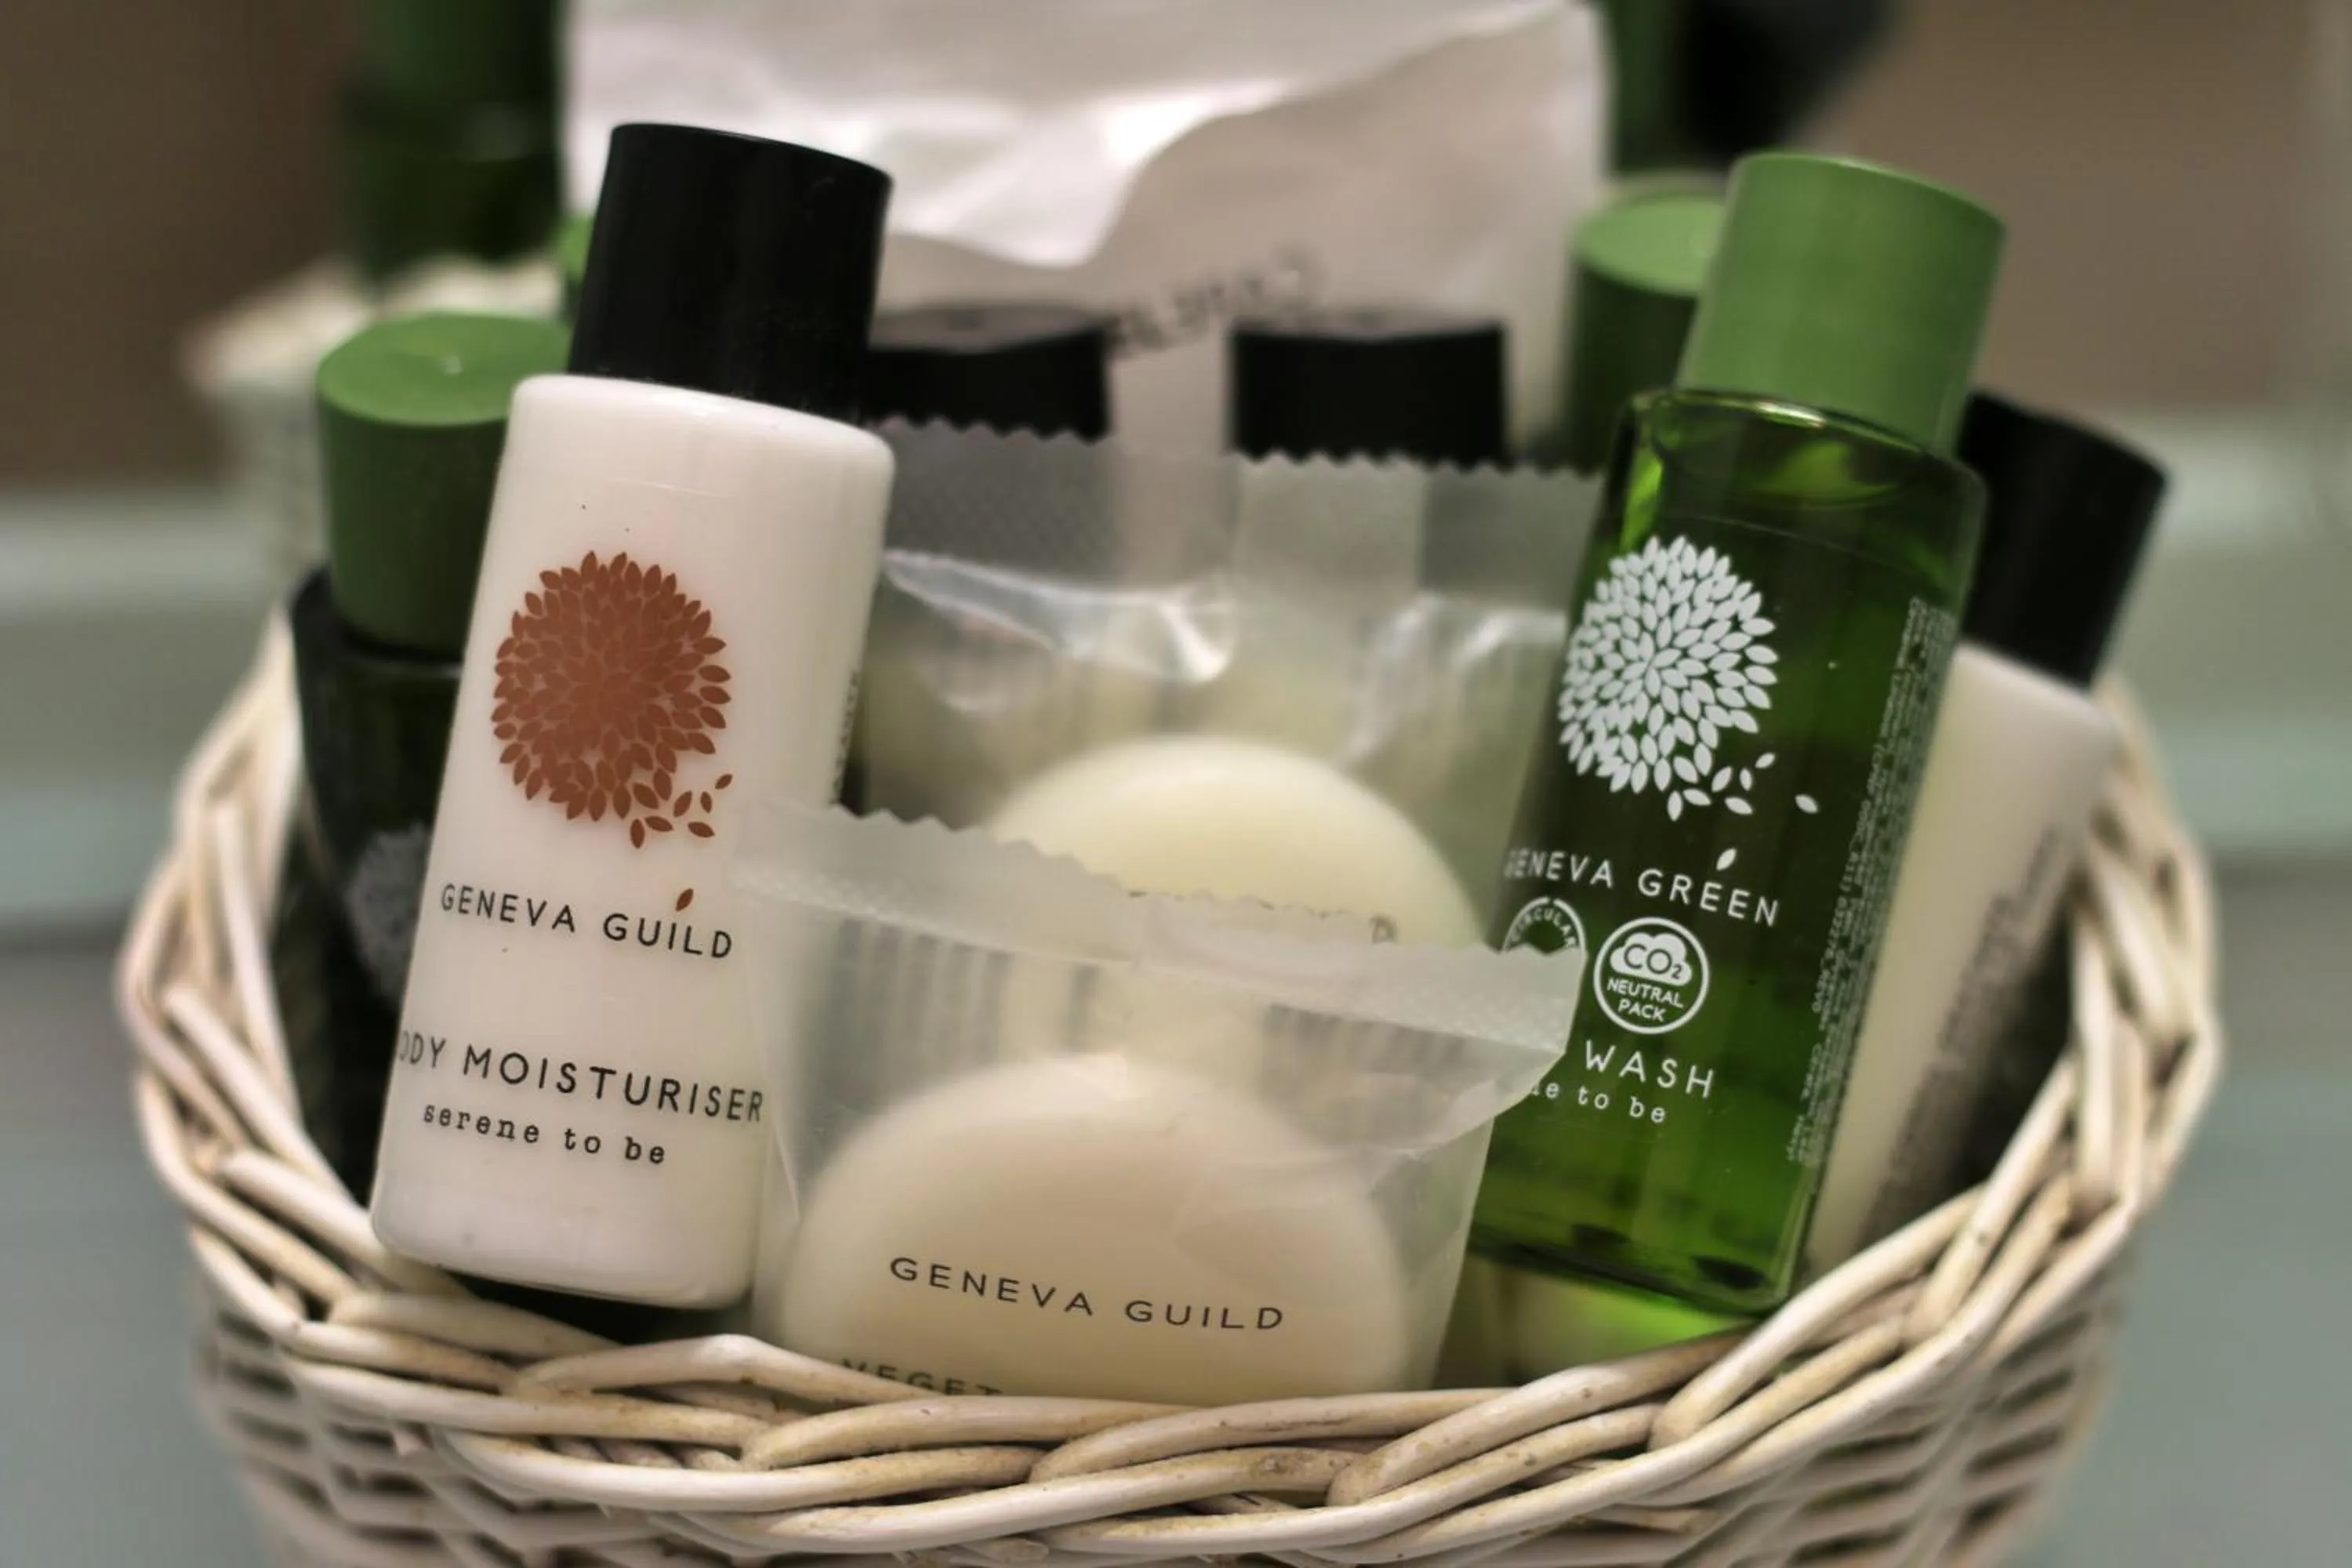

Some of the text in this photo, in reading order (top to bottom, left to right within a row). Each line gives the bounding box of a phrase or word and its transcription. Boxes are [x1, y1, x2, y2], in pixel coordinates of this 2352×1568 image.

[441, 883, 732, 958] GENEVA GUILD
[1638, 869, 1778, 927] GREEN
[1607, 978, 1683, 1008] NEUTRAL
[1618, 998, 1666, 1022] PACK
[463, 1044, 764, 1122] MOISTURISER
[1585, 1039, 1715, 1099] WASH
[423, 1104, 665, 1164] serene to be
[1578, 1086, 1609, 1109] to
[1629, 1096, 1665, 1123] be
[890, 1257, 1283, 1330] GENEVA GUILD
